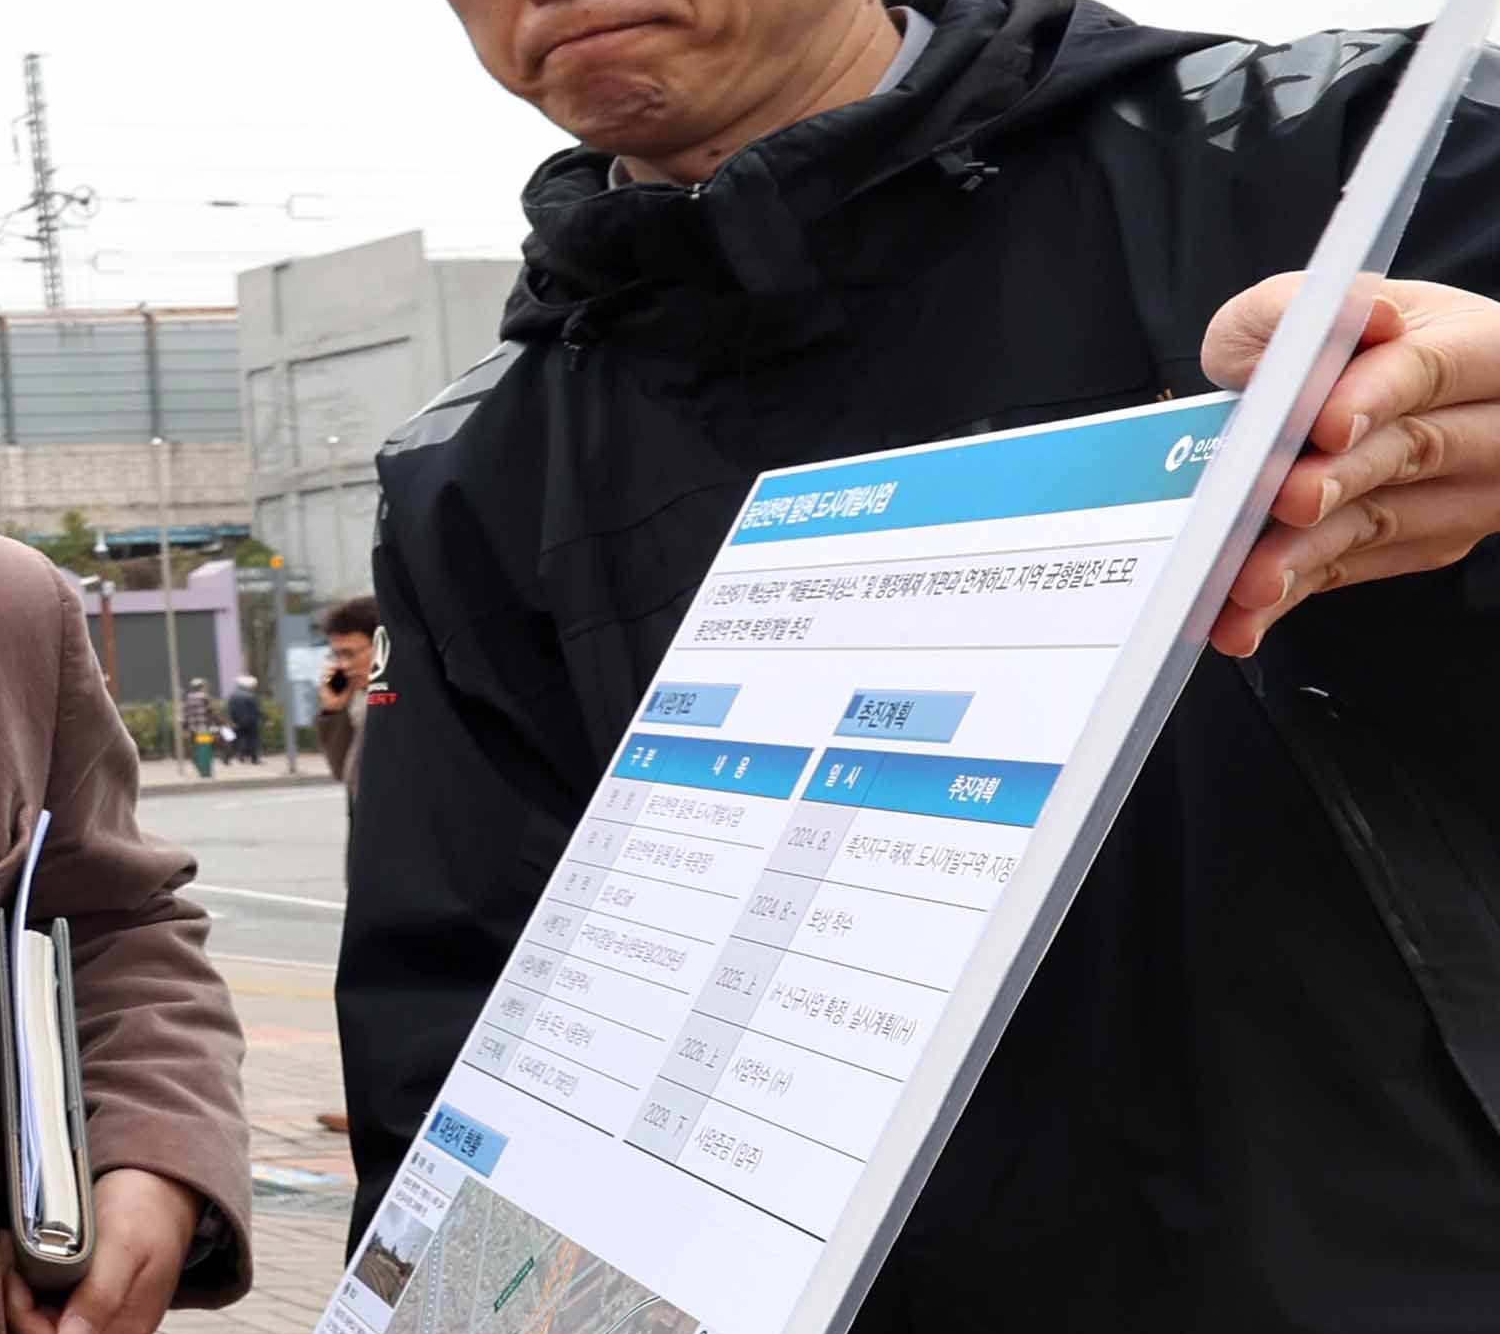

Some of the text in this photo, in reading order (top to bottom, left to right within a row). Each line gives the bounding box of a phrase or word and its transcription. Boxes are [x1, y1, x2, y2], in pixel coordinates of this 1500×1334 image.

[740, 481, 898, 530] 동인천역 일원 도시개발사업
[861, 575, 878, 597] 및
[874, 571, 928, 598] 행정체제
[922, 570, 964, 596] 개편과
[959, 566, 1017, 594] 연계하고
[1013, 564, 1047, 591] 지역
[1041, 559, 1106, 590] 균형발전
[1099, 557, 1138, 584] 도모,
[788, 616, 813, 640] 추진
[857, 700, 915, 729] 추진계획
[948, 774, 1002, 803] 추진계획
[914, 845, 989, 877] 도시개발구역
[780, 988, 825, 1017] 신규사업
